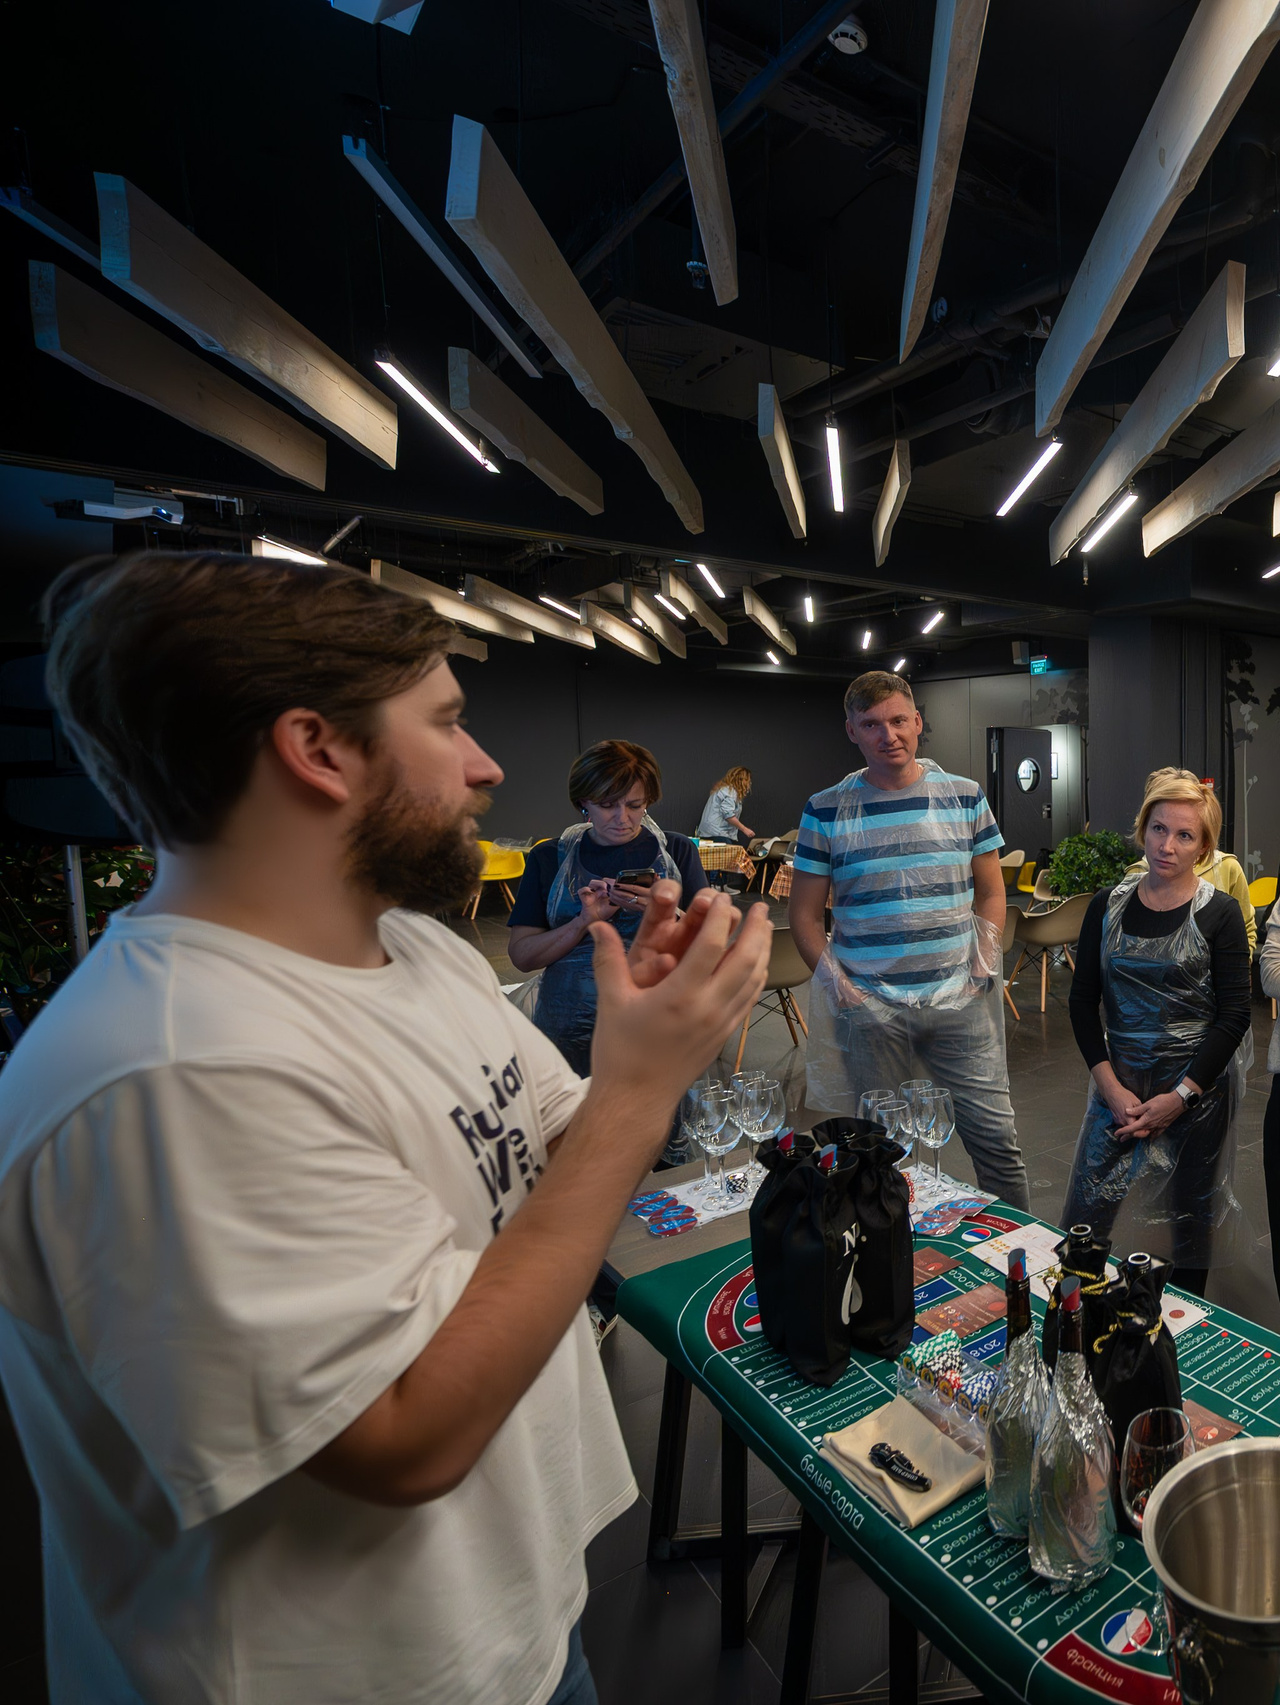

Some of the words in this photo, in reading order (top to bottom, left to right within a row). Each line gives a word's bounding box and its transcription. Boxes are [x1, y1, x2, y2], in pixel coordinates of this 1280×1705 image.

[969, 1339, 1001, 1357] 2018
[1250, 1385, 1274, 1403] Нуар
[826, 1404, 874, 1431] Кортезе
[1227, 1408, 1256, 1428] 11%
[800, 1453, 833, 1496] белые
[830, 1489, 866, 1531] сорта
[1055, 1588, 1099, 1626] Другой
[1066, 1647, 1125, 1689] Франция
